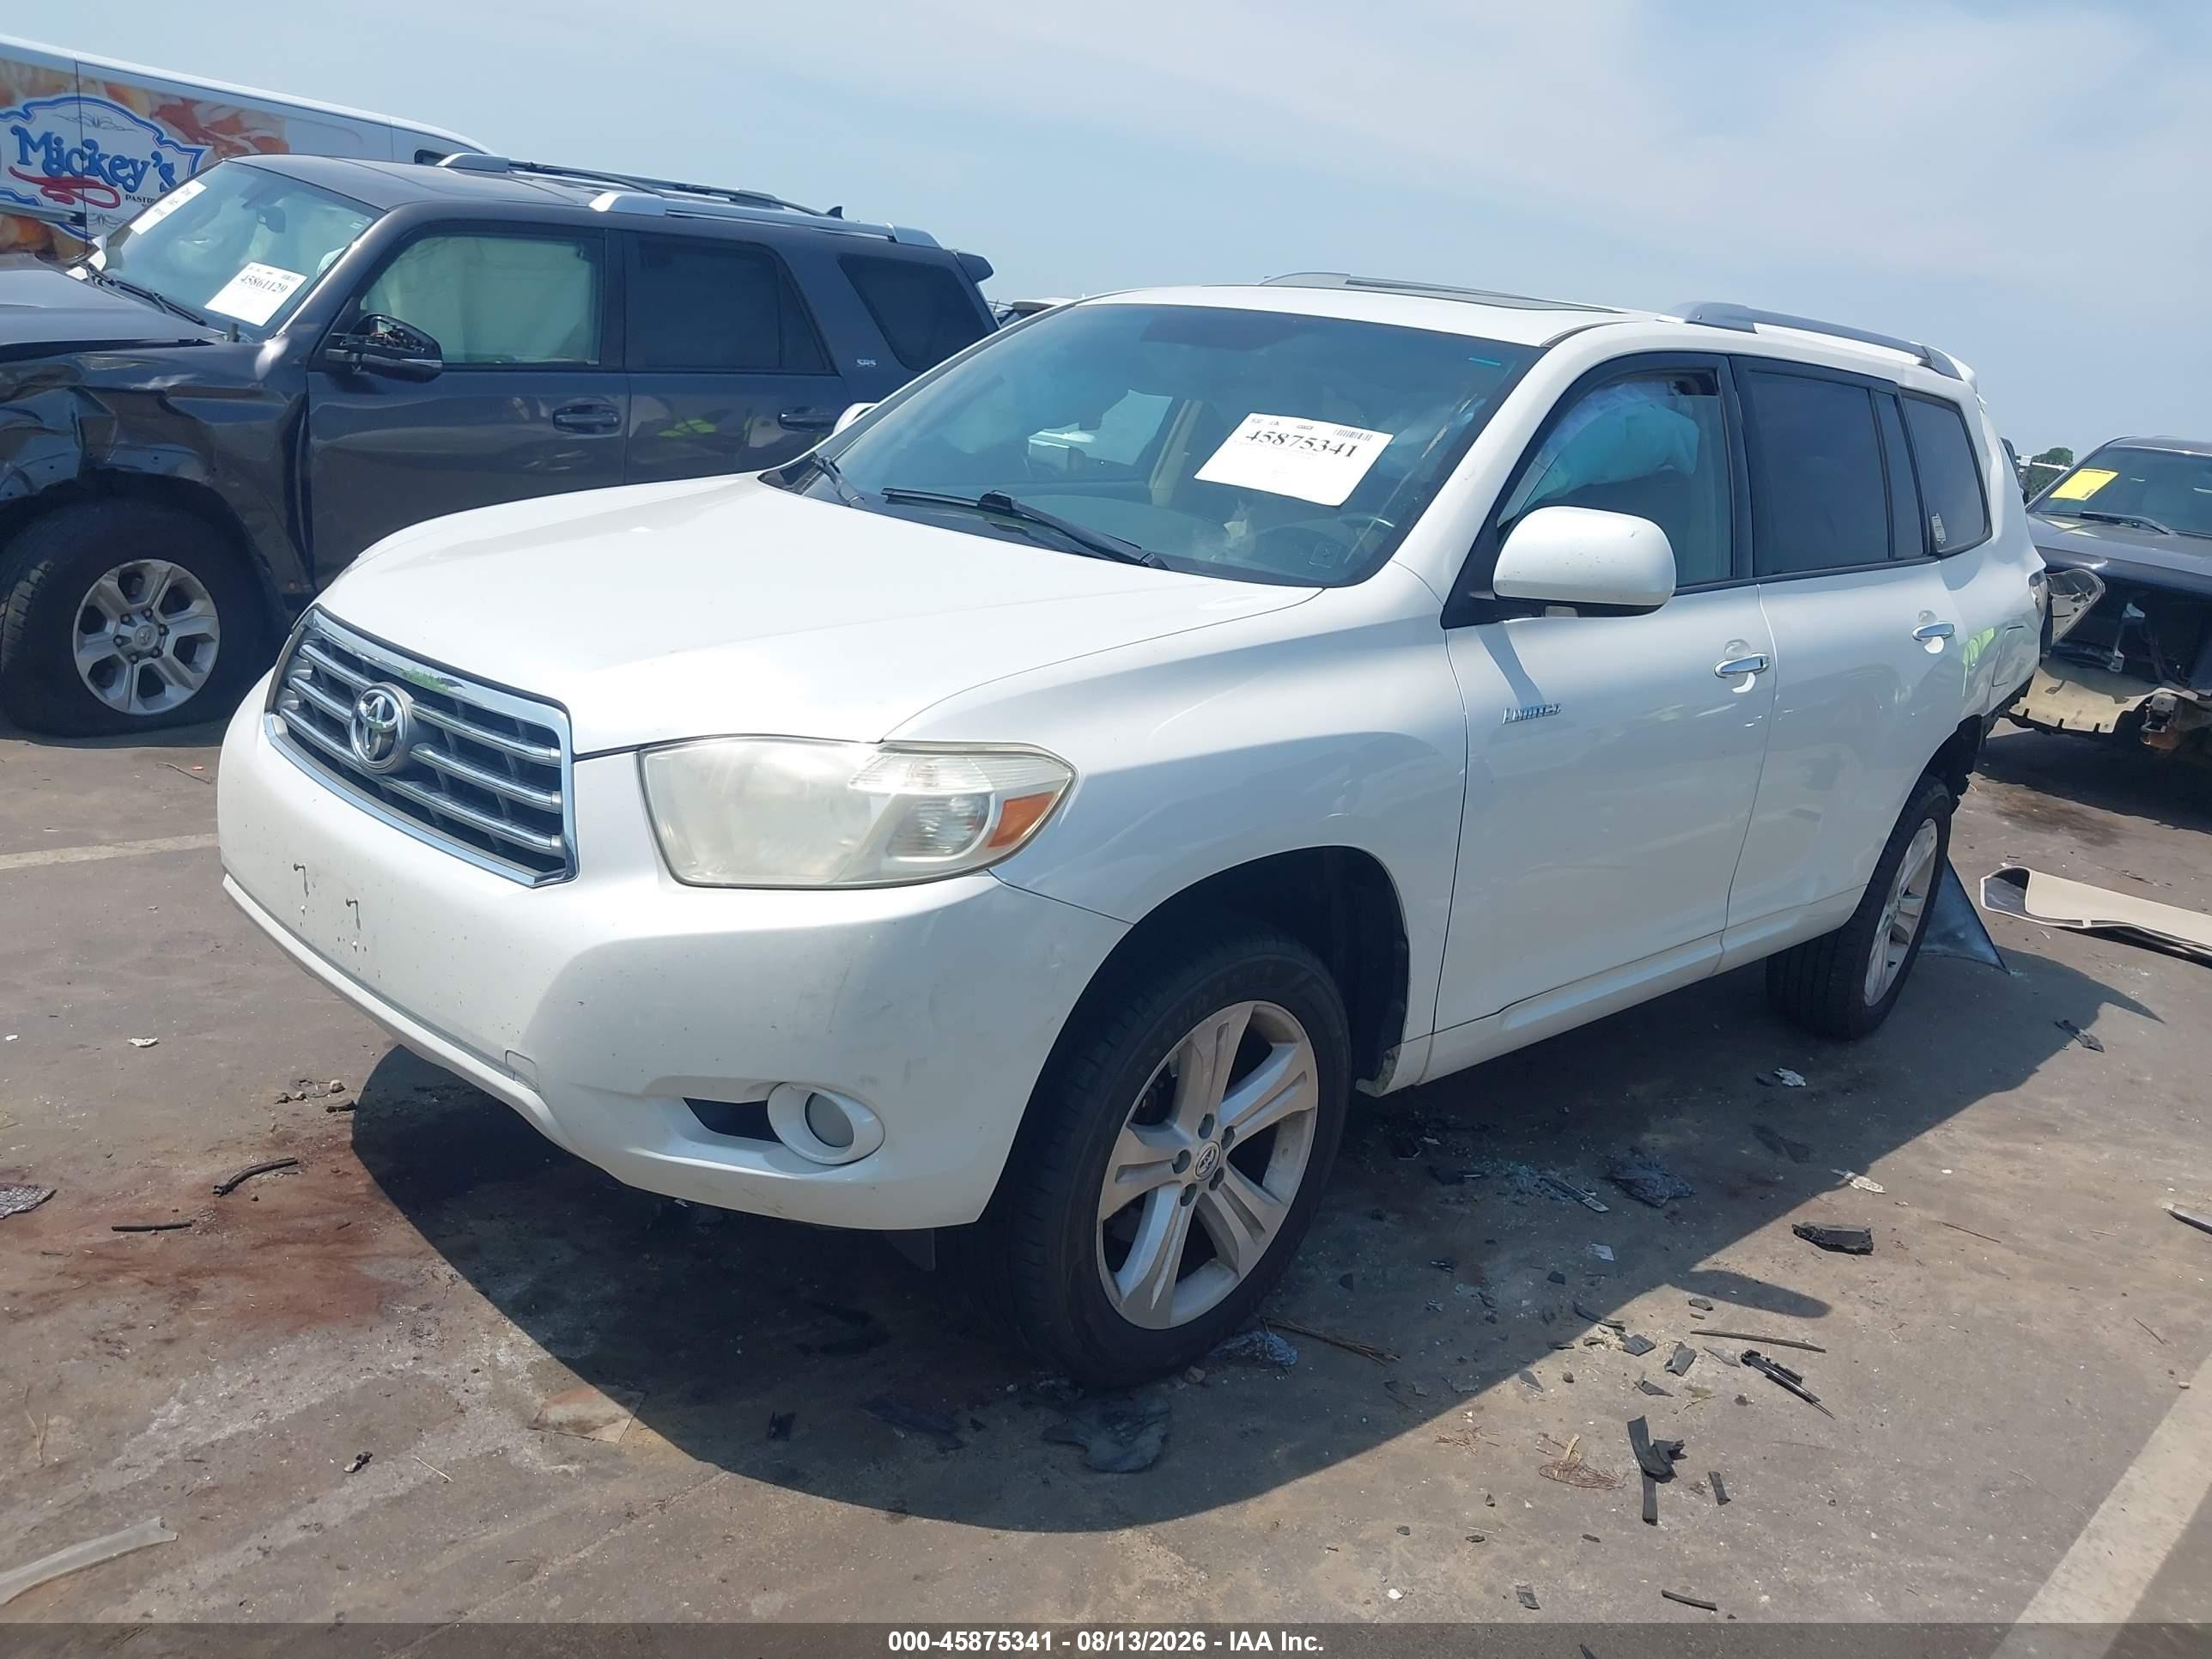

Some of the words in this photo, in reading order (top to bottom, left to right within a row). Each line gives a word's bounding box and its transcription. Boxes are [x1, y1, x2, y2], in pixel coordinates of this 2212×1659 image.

[10, 125, 177, 193] Mickey's
[125, 194, 155, 204] PASTR
[1245, 429, 1358, 458] 45875341
